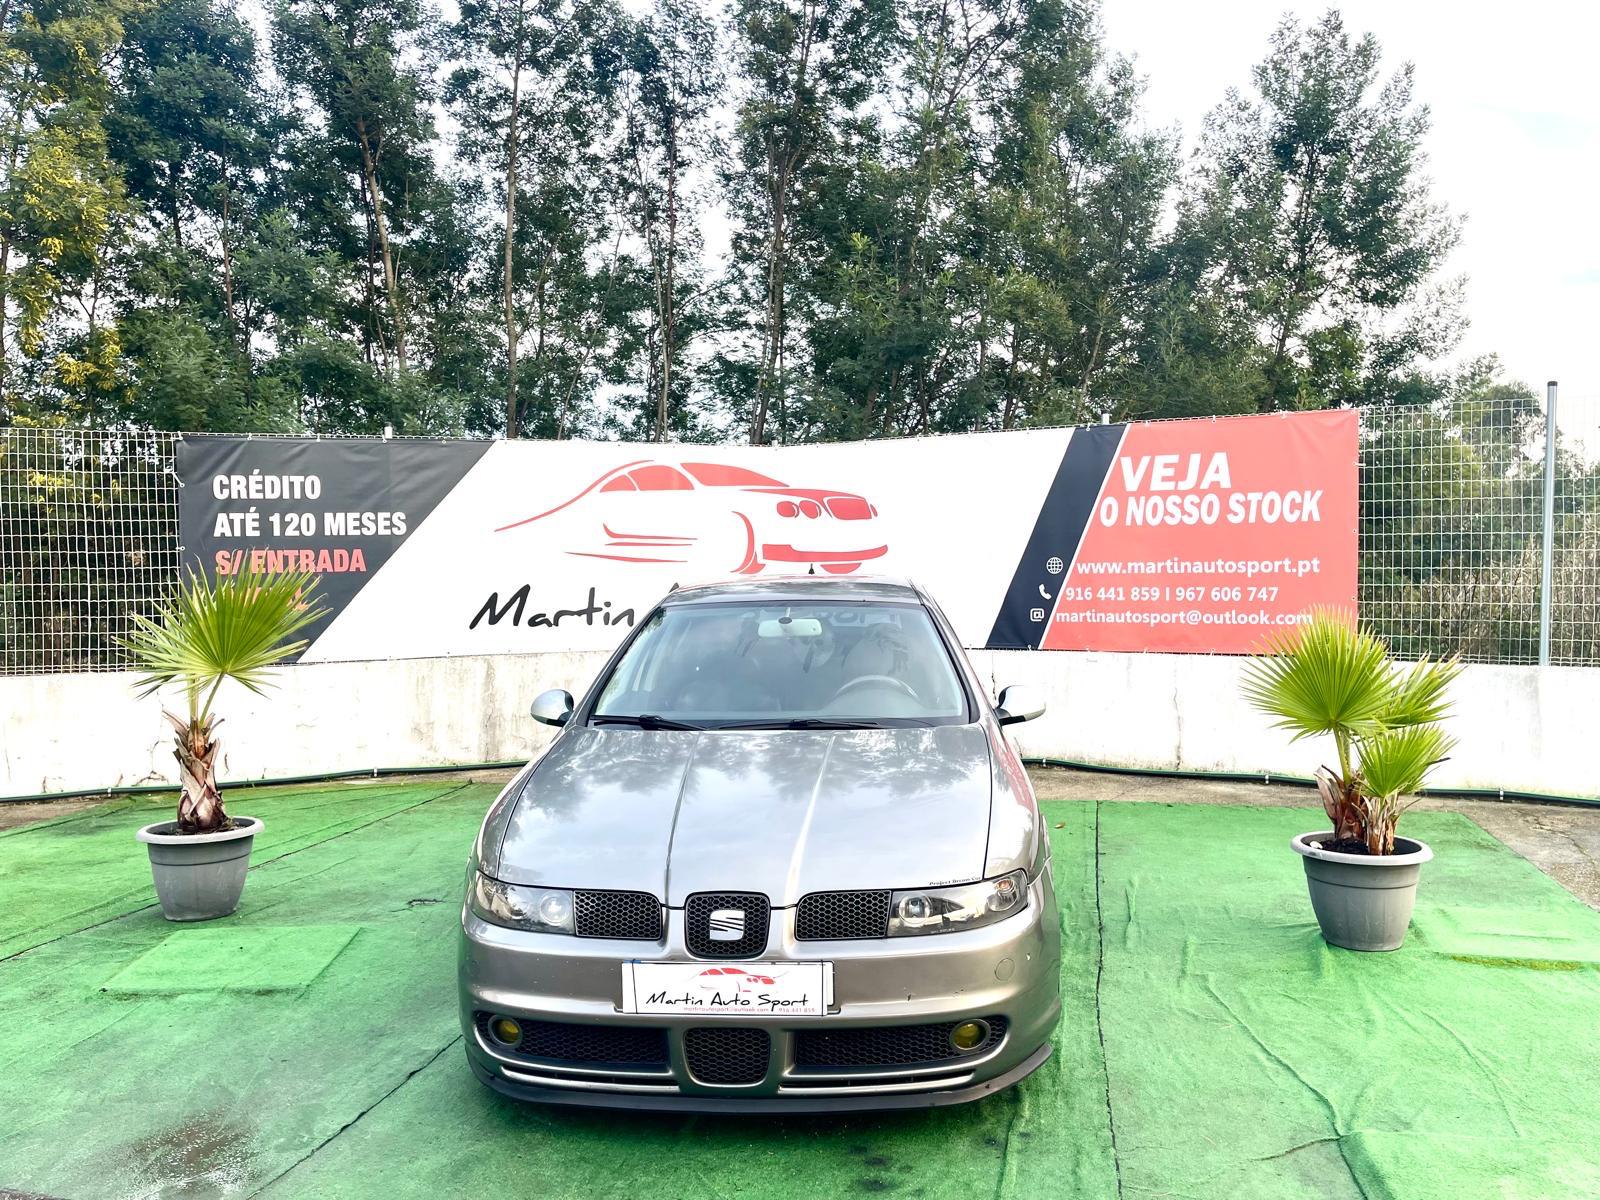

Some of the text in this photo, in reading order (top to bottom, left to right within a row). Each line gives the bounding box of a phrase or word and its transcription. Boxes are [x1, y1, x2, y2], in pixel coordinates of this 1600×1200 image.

[212, 469, 321, 500] CRÉDITO
[1119, 452, 1232, 492] VEJA
[213, 507, 407, 537] ATÉ 120 MESES
[1100, 490, 1323, 527] O NOSSO STOCK
[215, 549, 367, 575] S/ ENTRADA
[1077, 557, 1320, 577] www.martinautosport.pt
[469, 584, 635, 630] Martin
[1065, 587, 1093, 601] 916
[1097, 587, 1125, 601] 441
[1130, 587, 1160, 601] 859
[1175, 587, 1205, 601] 967
[1210, 587, 1241, 601] 606
[1247, 586, 1279, 601] 747
[1056, 609, 1313, 626] martinautosport@outlook.com
[646, 991, 809, 1012] Martin Auto Sport
